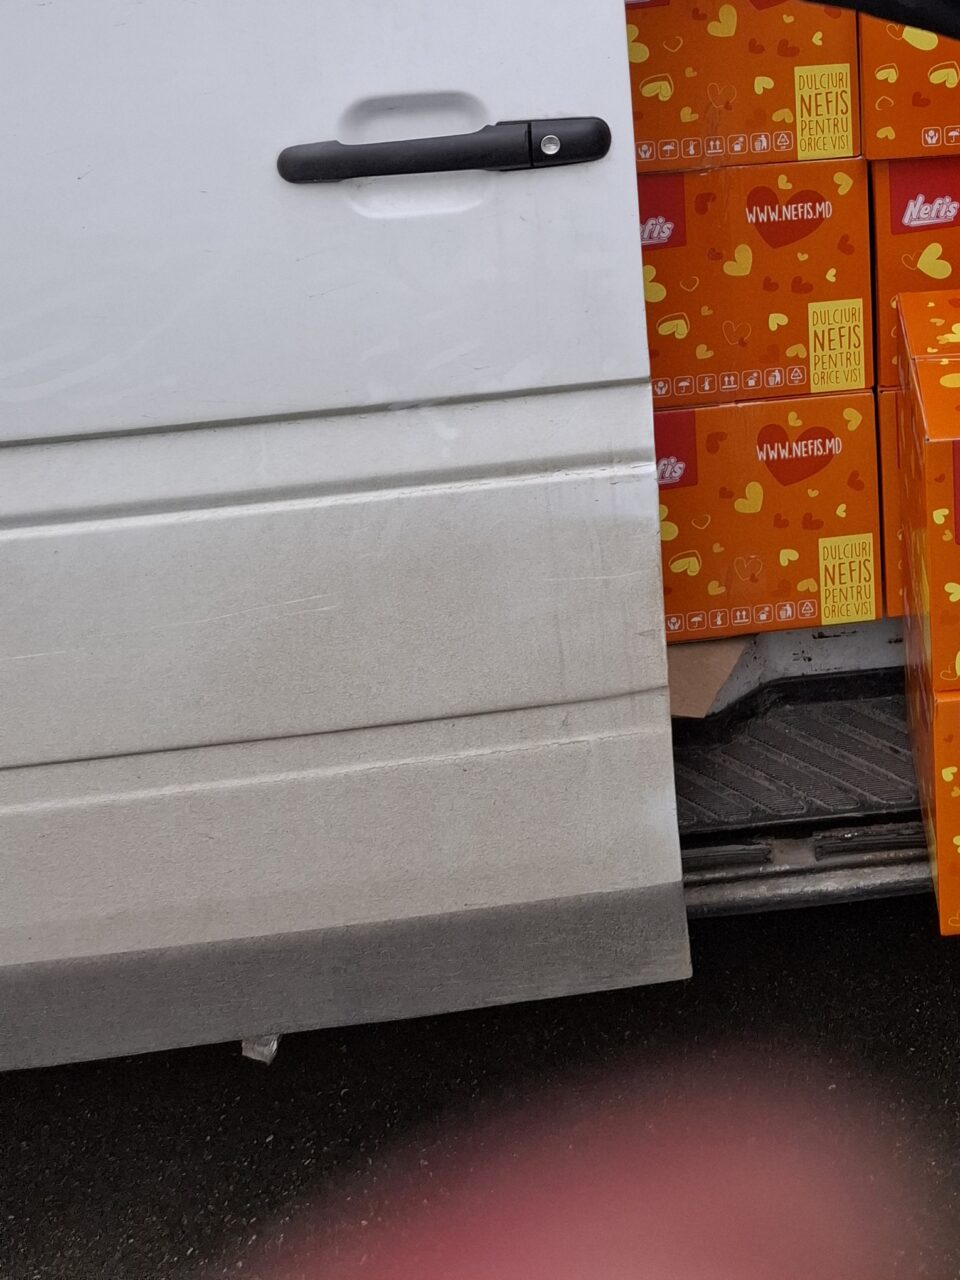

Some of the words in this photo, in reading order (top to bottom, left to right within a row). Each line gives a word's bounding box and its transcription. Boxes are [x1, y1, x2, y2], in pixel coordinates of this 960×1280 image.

[798, 72, 848, 91] DULCIURI
[800, 90, 849, 119] NEFIS
[801, 117, 849, 138] PENTRU
[799, 137, 828, 152] ORICE
[745, 201, 833, 225] WWW.NEFIS.MD
[901, 193, 960, 228] Nefis
[640, 215, 675, 246] fis
[812, 306, 861, 327] DULCIURI
[813, 324, 862, 353] NEFIS
[814, 351, 861, 371] PENTRU
[812, 370, 841, 386] ORICE
[756, 437, 843, 462] WWW.NEFIS.MD
[658, 456, 686, 485] fis
[822, 540, 872, 561] DULCIURI
[823, 558, 872, 587] NEFIS
[824, 585, 872, 605] PENTRU
[823, 603, 852, 619] ORICE
